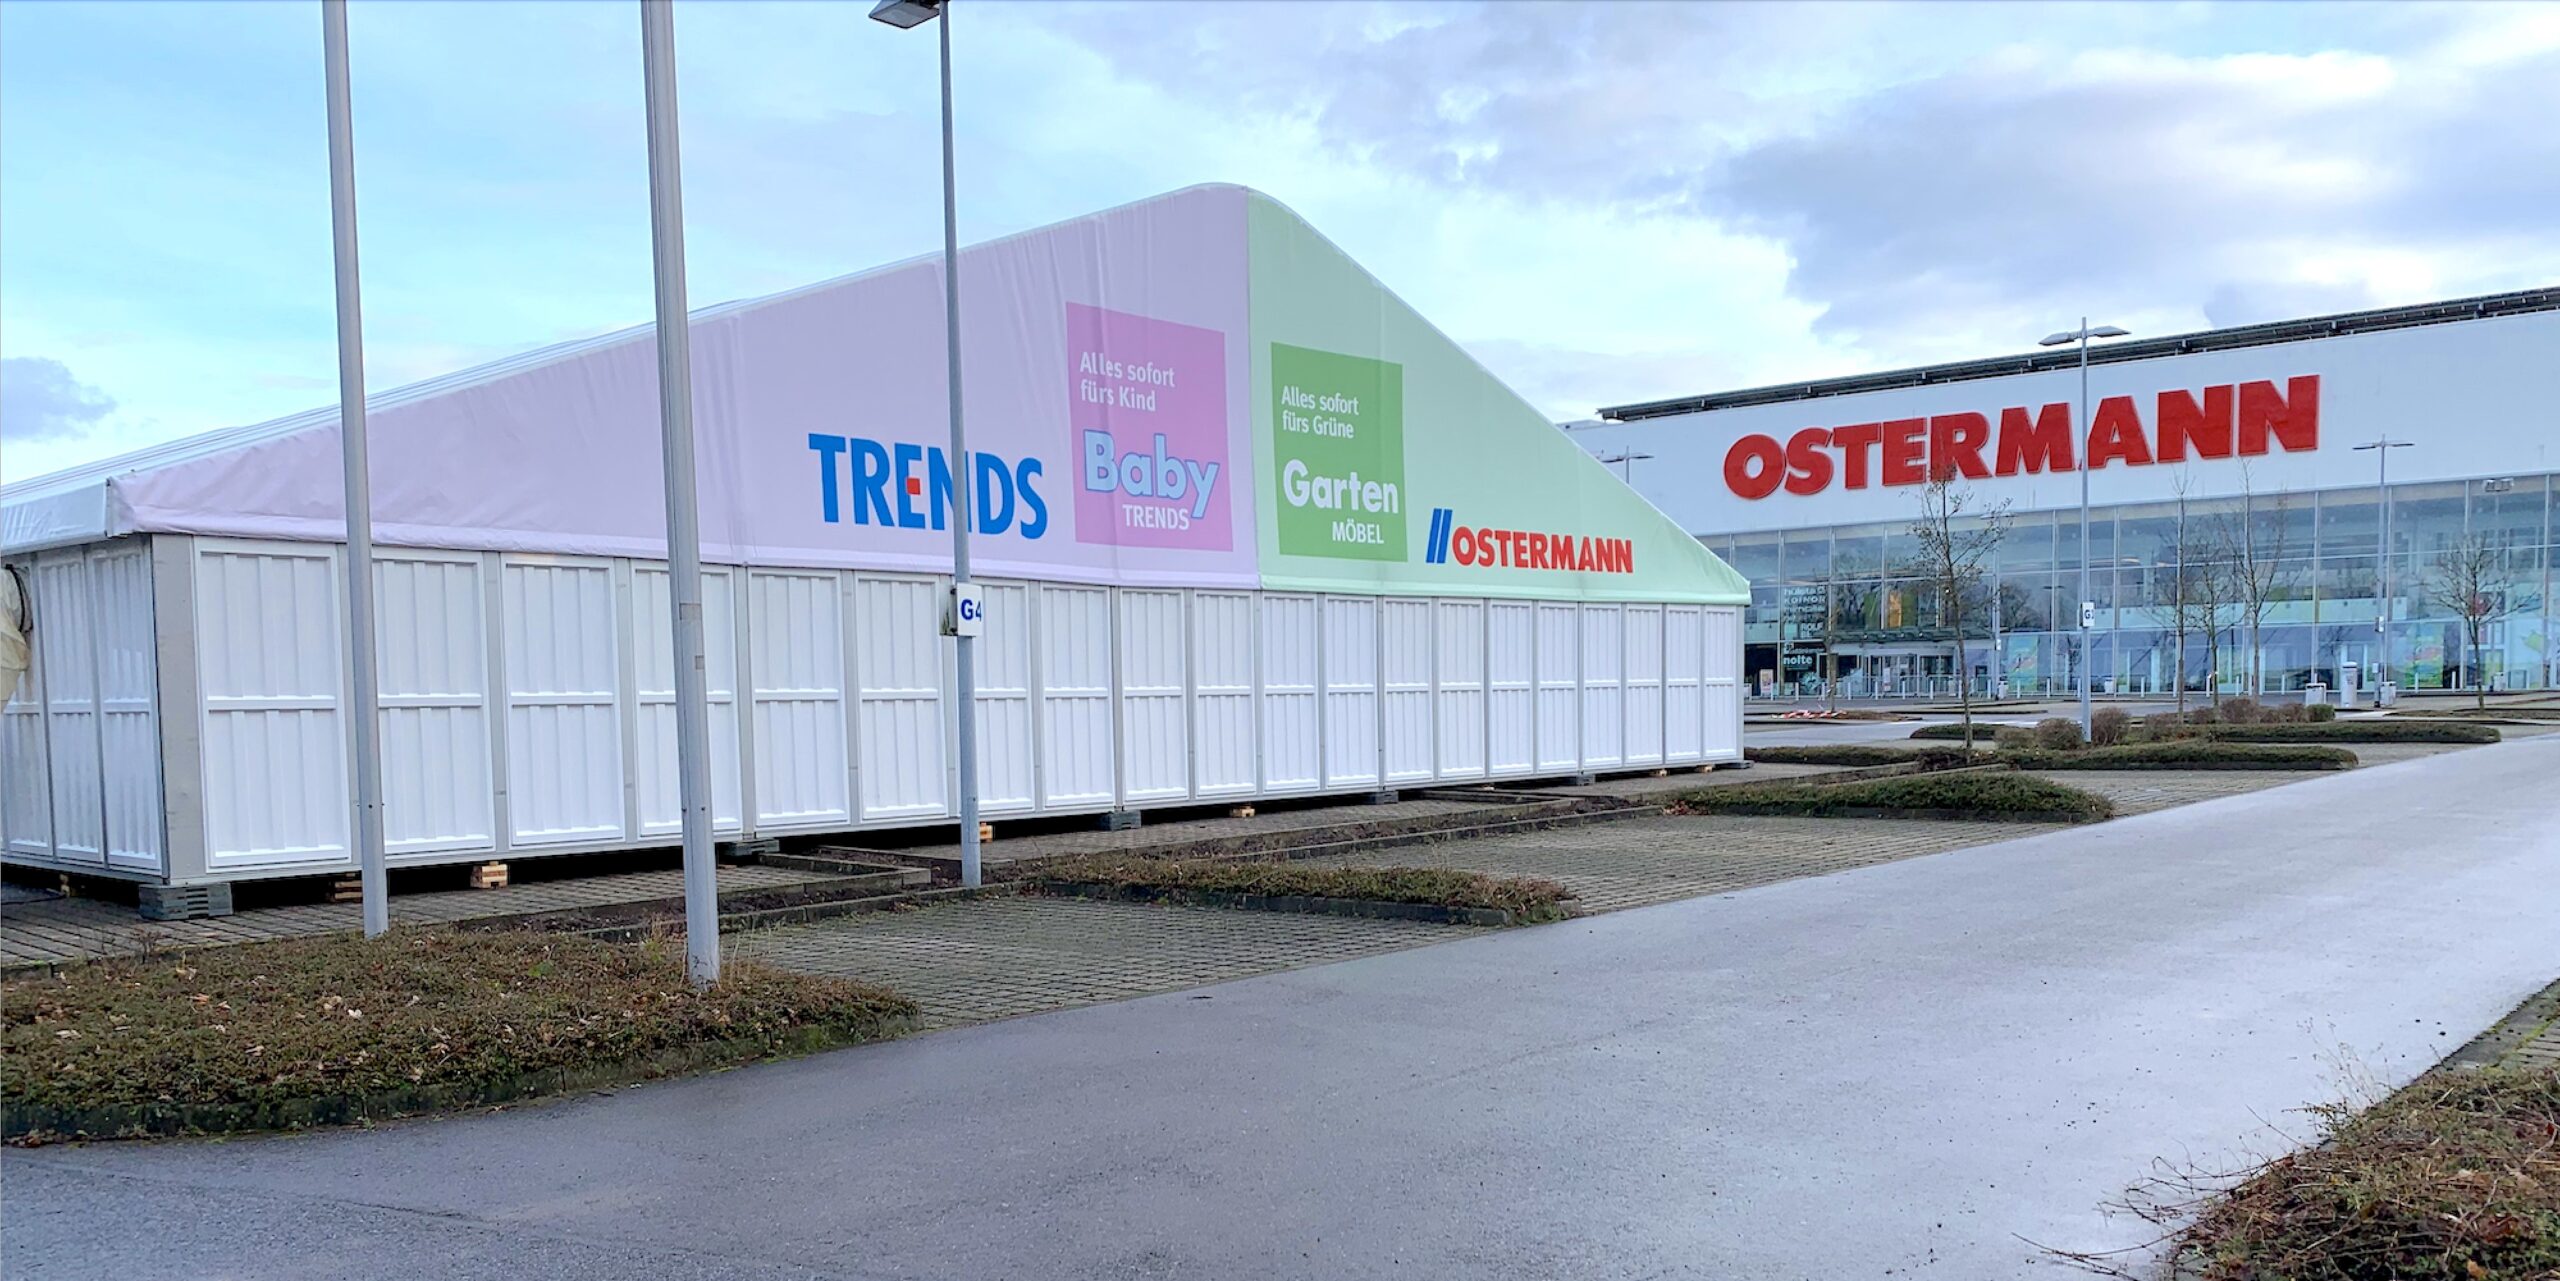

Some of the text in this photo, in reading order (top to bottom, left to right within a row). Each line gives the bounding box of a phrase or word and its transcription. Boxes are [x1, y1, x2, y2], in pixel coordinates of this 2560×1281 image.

[1080, 351, 1176, 388] Alles sofort
[1081, 379, 1156, 412] fürs Kind
[1281, 385, 1360, 416] Alles sofort
[1282, 410, 1354, 439] fürs Grüne
[1723, 375, 2321, 500] OSTERMANN
[808, 433, 1048, 540] TRENDS
[1083, 428, 1220, 519] Baby
[1283, 459, 1399, 514] Garten
[1122, 504, 1190, 531] TRENDS
[1332, 518, 1385, 544] MÖBEL
[1452, 526, 1634, 573] OSTERMANN
[961, 599, 982, 622] G4
[1783, 655, 1813, 665] nolte
